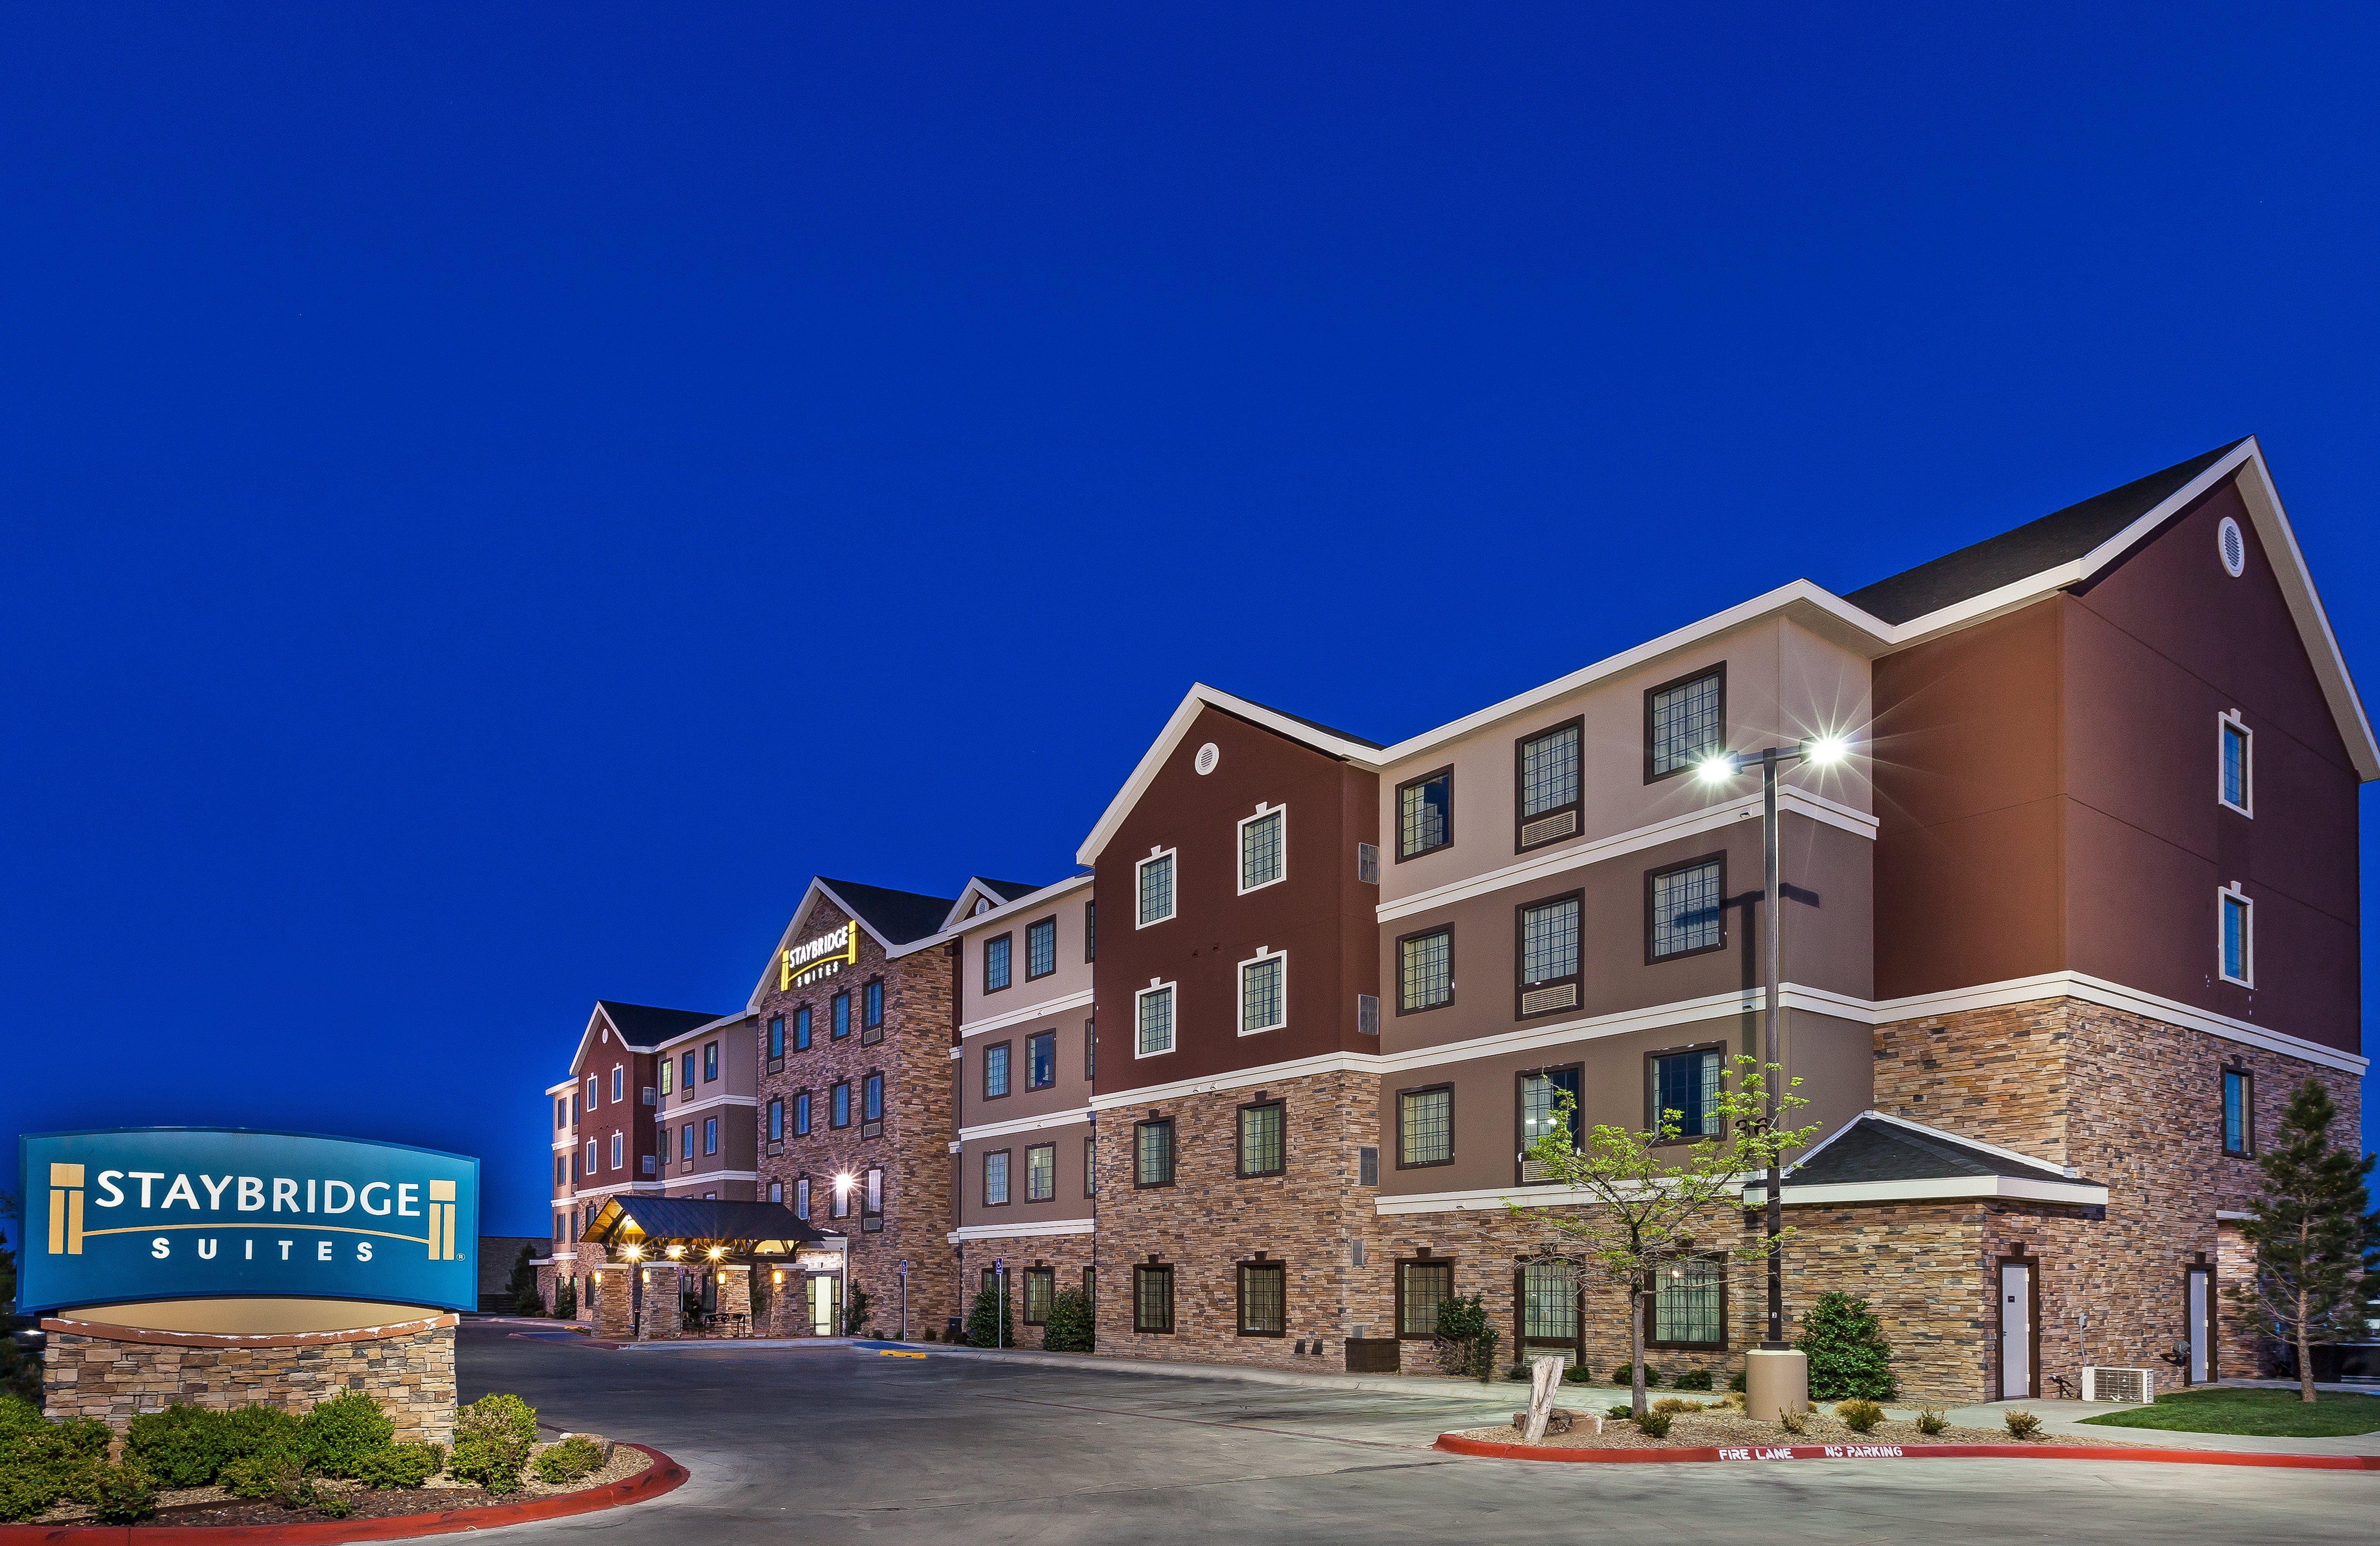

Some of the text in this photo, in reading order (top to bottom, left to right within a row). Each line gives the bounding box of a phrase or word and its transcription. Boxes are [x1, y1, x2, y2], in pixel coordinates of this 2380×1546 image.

[789, 926, 848, 968] STAYBRIDGE
[797, 961, 839, 987] SUITES
[95, 1170, 421, 1216] STAYBRIDGE
[151, 1237, 373, 1262] SUITES
[1719, 1446, 1903, 1460] FIRE LANE NO PARKING
